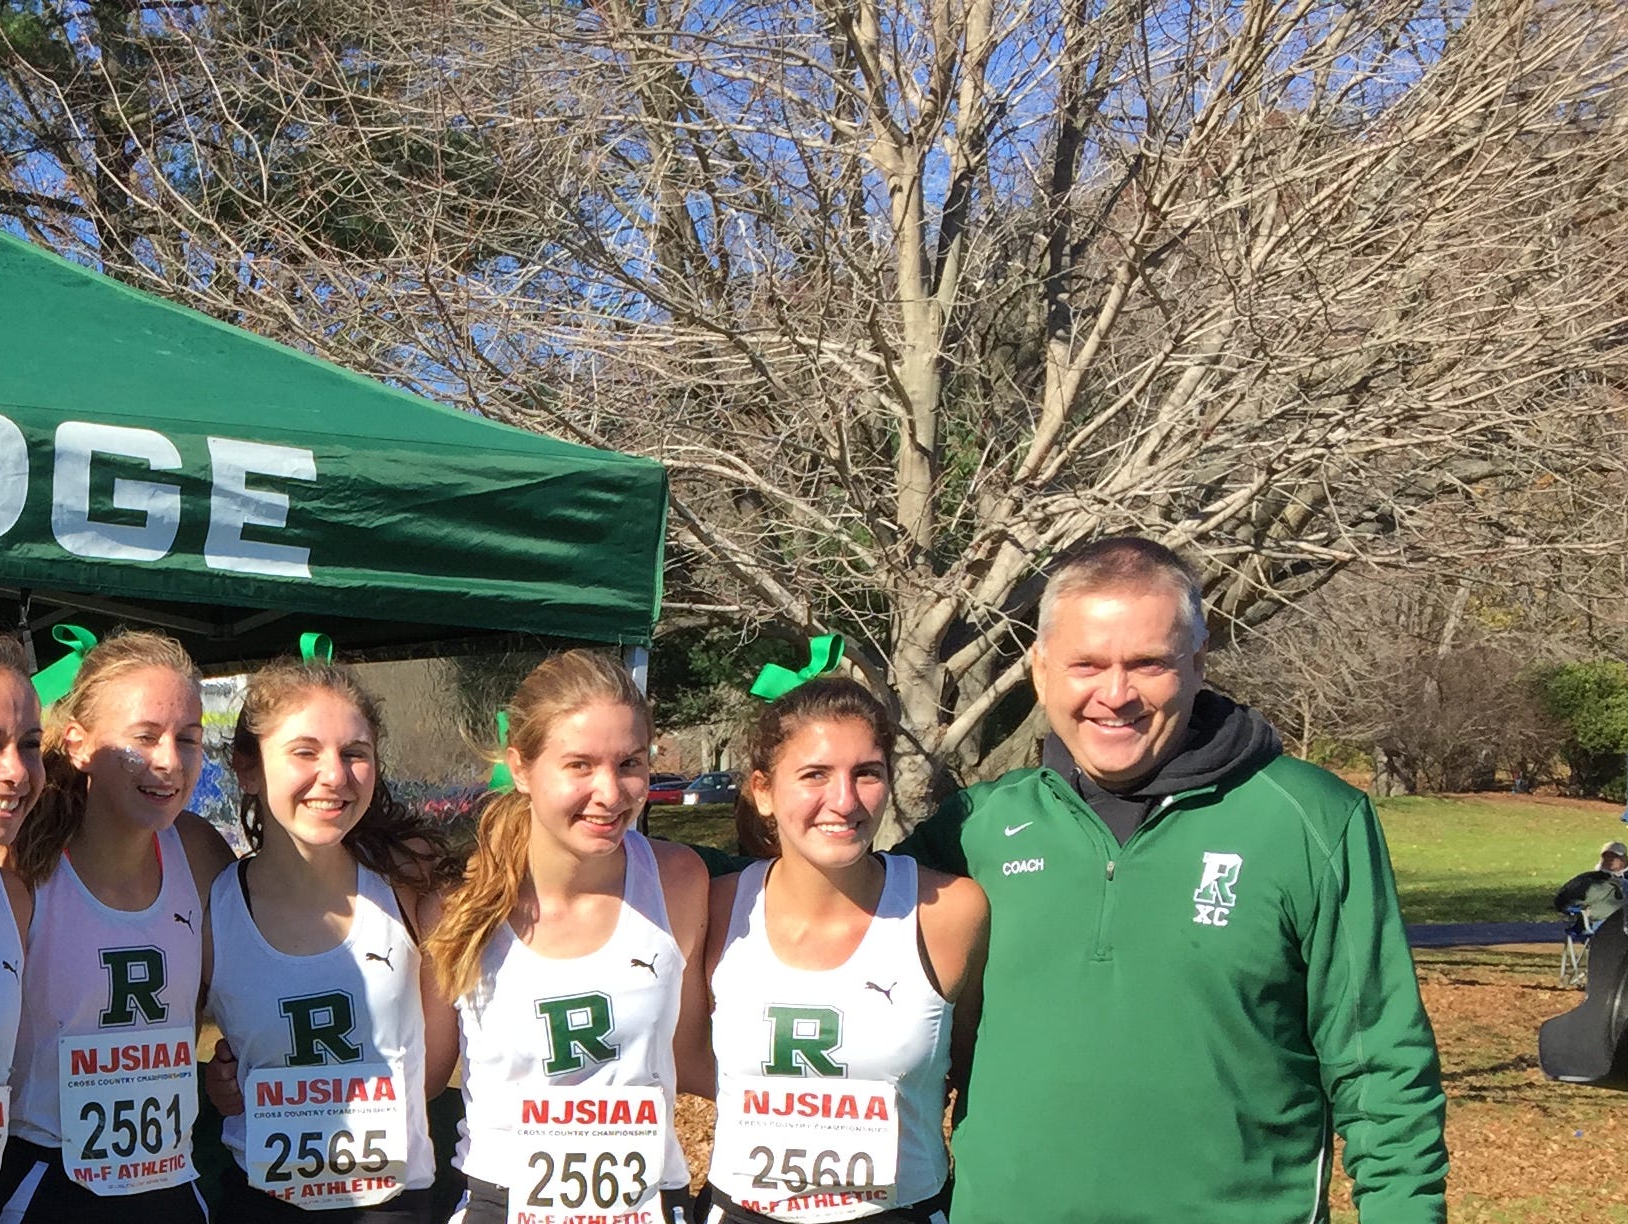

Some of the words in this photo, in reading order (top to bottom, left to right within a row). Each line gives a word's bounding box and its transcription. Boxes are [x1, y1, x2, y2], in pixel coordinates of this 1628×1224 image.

[1002, 858, 1044, 876] COACH
[1193, 851, 1243, 907] R
[1192, 904, 1230, 927] XC
[98, 945, 169, 1028] R
[278, 989, 363, 1067] R
[534, 990, 620, 1077] R
[761, 1003, 848, 1079] R
[71, 1041, 192, 1076] NJSIAA
[67, 1079, 96, 1088] CROSS
[98, 1076, 135, 1086] COUNTRY
[257, 1076, 397, 1107] NJSIAA
[254, 1111, 282, 1119] CROSS
[284, 1109, 324, 1118] COUNTRY
[521, 1099, 658, 1125] NJSIAA
[743, 1089, 889, 1121] NJSIAA
[79, 1094, 182, 1161] 2561
[591, 1129, 658, 1137] CHAMPIONSHIPS
[73, 1165, 112, 1182] M-F
[117, 1153, 186, 1180] ATHLETIC
[264, 1130, 389, 1183] 2565
[749, 1145, 874, 1193] 2560
[301, 1175, 397, 1198] ATHLETIC
[526, 1151, 647, 1209] 2563
[741, 1199, 780, 1213] M-F
[787, 1190, 888, 1212] ATHLETIC
